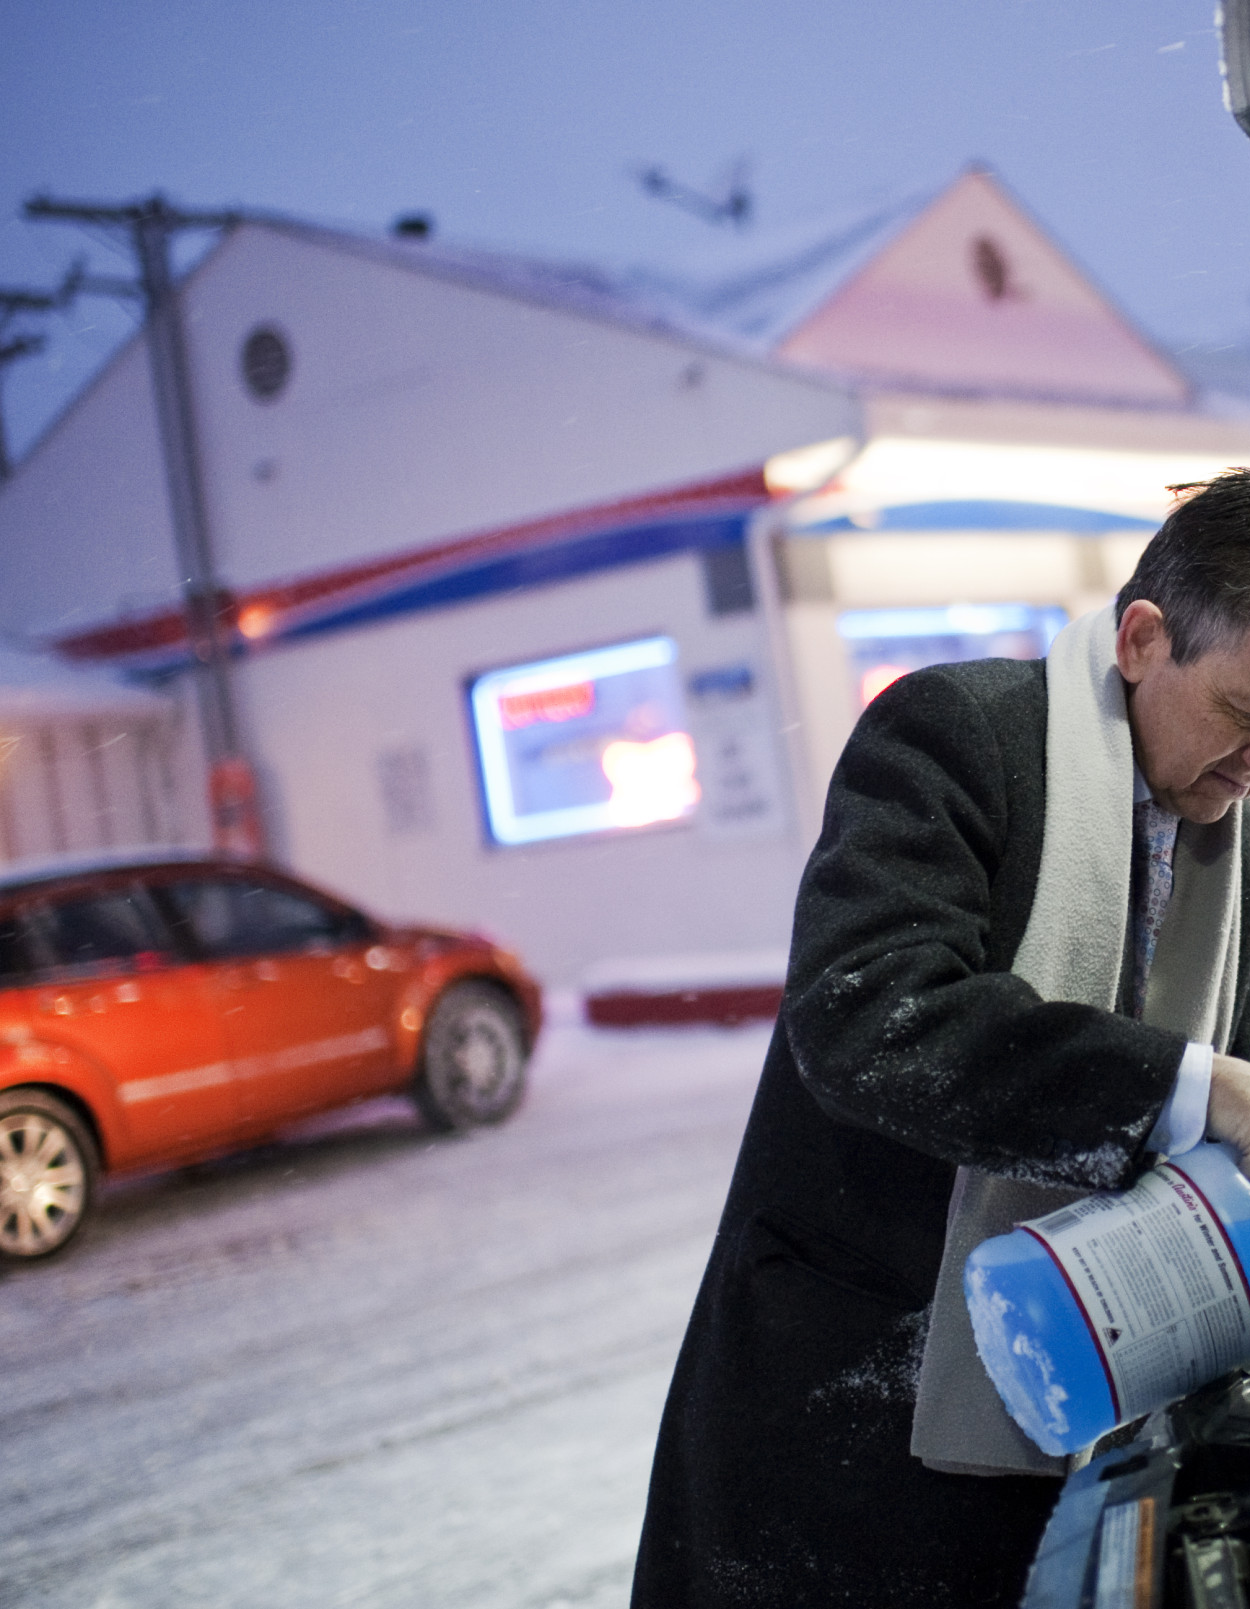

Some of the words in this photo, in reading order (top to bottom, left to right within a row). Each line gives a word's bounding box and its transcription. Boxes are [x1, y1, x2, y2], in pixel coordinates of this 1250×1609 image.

[1172, 1184, 1198, 1211] Austin's
[1193, 1214, 1202, 1223] for
[1200, 1224, 1215, 1247] Winter
[1211, 1248, 1223, 1261] and
[1088, 1273, 1099, 1291] REACH
[1100, 1298, 1115, 1324] CHILDREN
